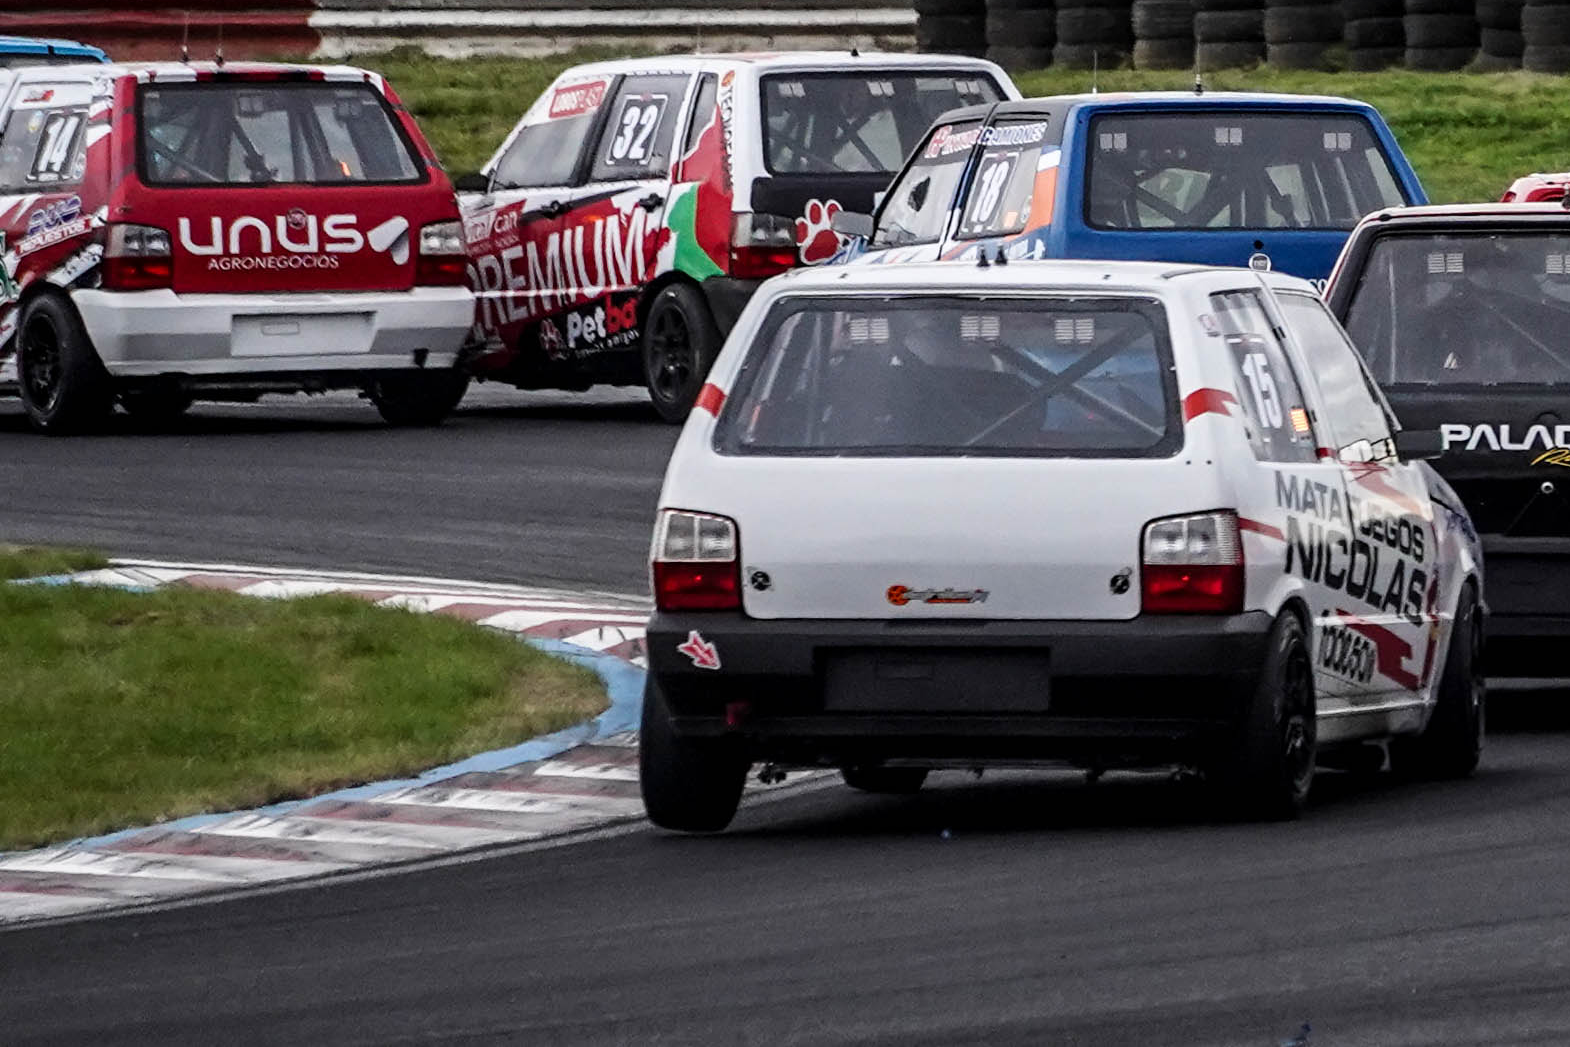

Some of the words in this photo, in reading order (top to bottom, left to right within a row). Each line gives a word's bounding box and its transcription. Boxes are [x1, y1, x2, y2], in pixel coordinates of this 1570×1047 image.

[37, 115, 80, 173] 14
[612, 104, 659, 160] 32
[971, 161, 1010, 223] 18
[208, 255, 340, 271] AGRONEGOCIOS
[1241, 353, 1283, 429] 15
[1283, 514, 1428, 628] NICOLAS
